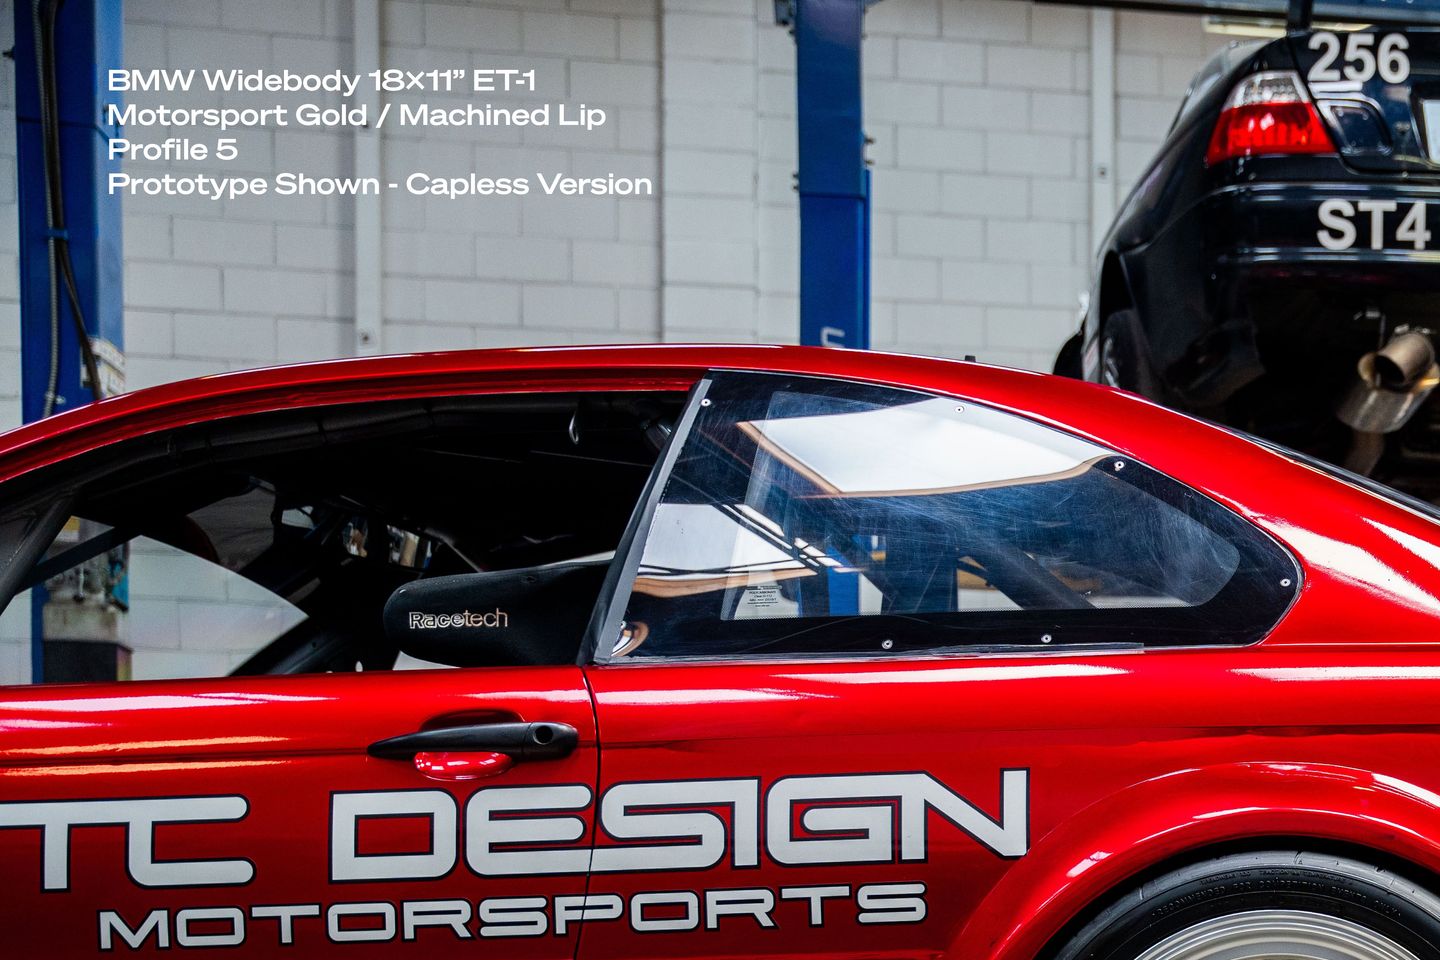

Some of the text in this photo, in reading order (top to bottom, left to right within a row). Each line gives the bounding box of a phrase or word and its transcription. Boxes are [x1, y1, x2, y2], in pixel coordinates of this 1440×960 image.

[1308, 31, 1411, 84] 256
[1316, 199, 1431, 251] ST4
[408, 608, 509, 630] Racetech
[329, 767, 1030, 884] DESIGN
[98, 880, 929, 953] MOTORSPORTS
